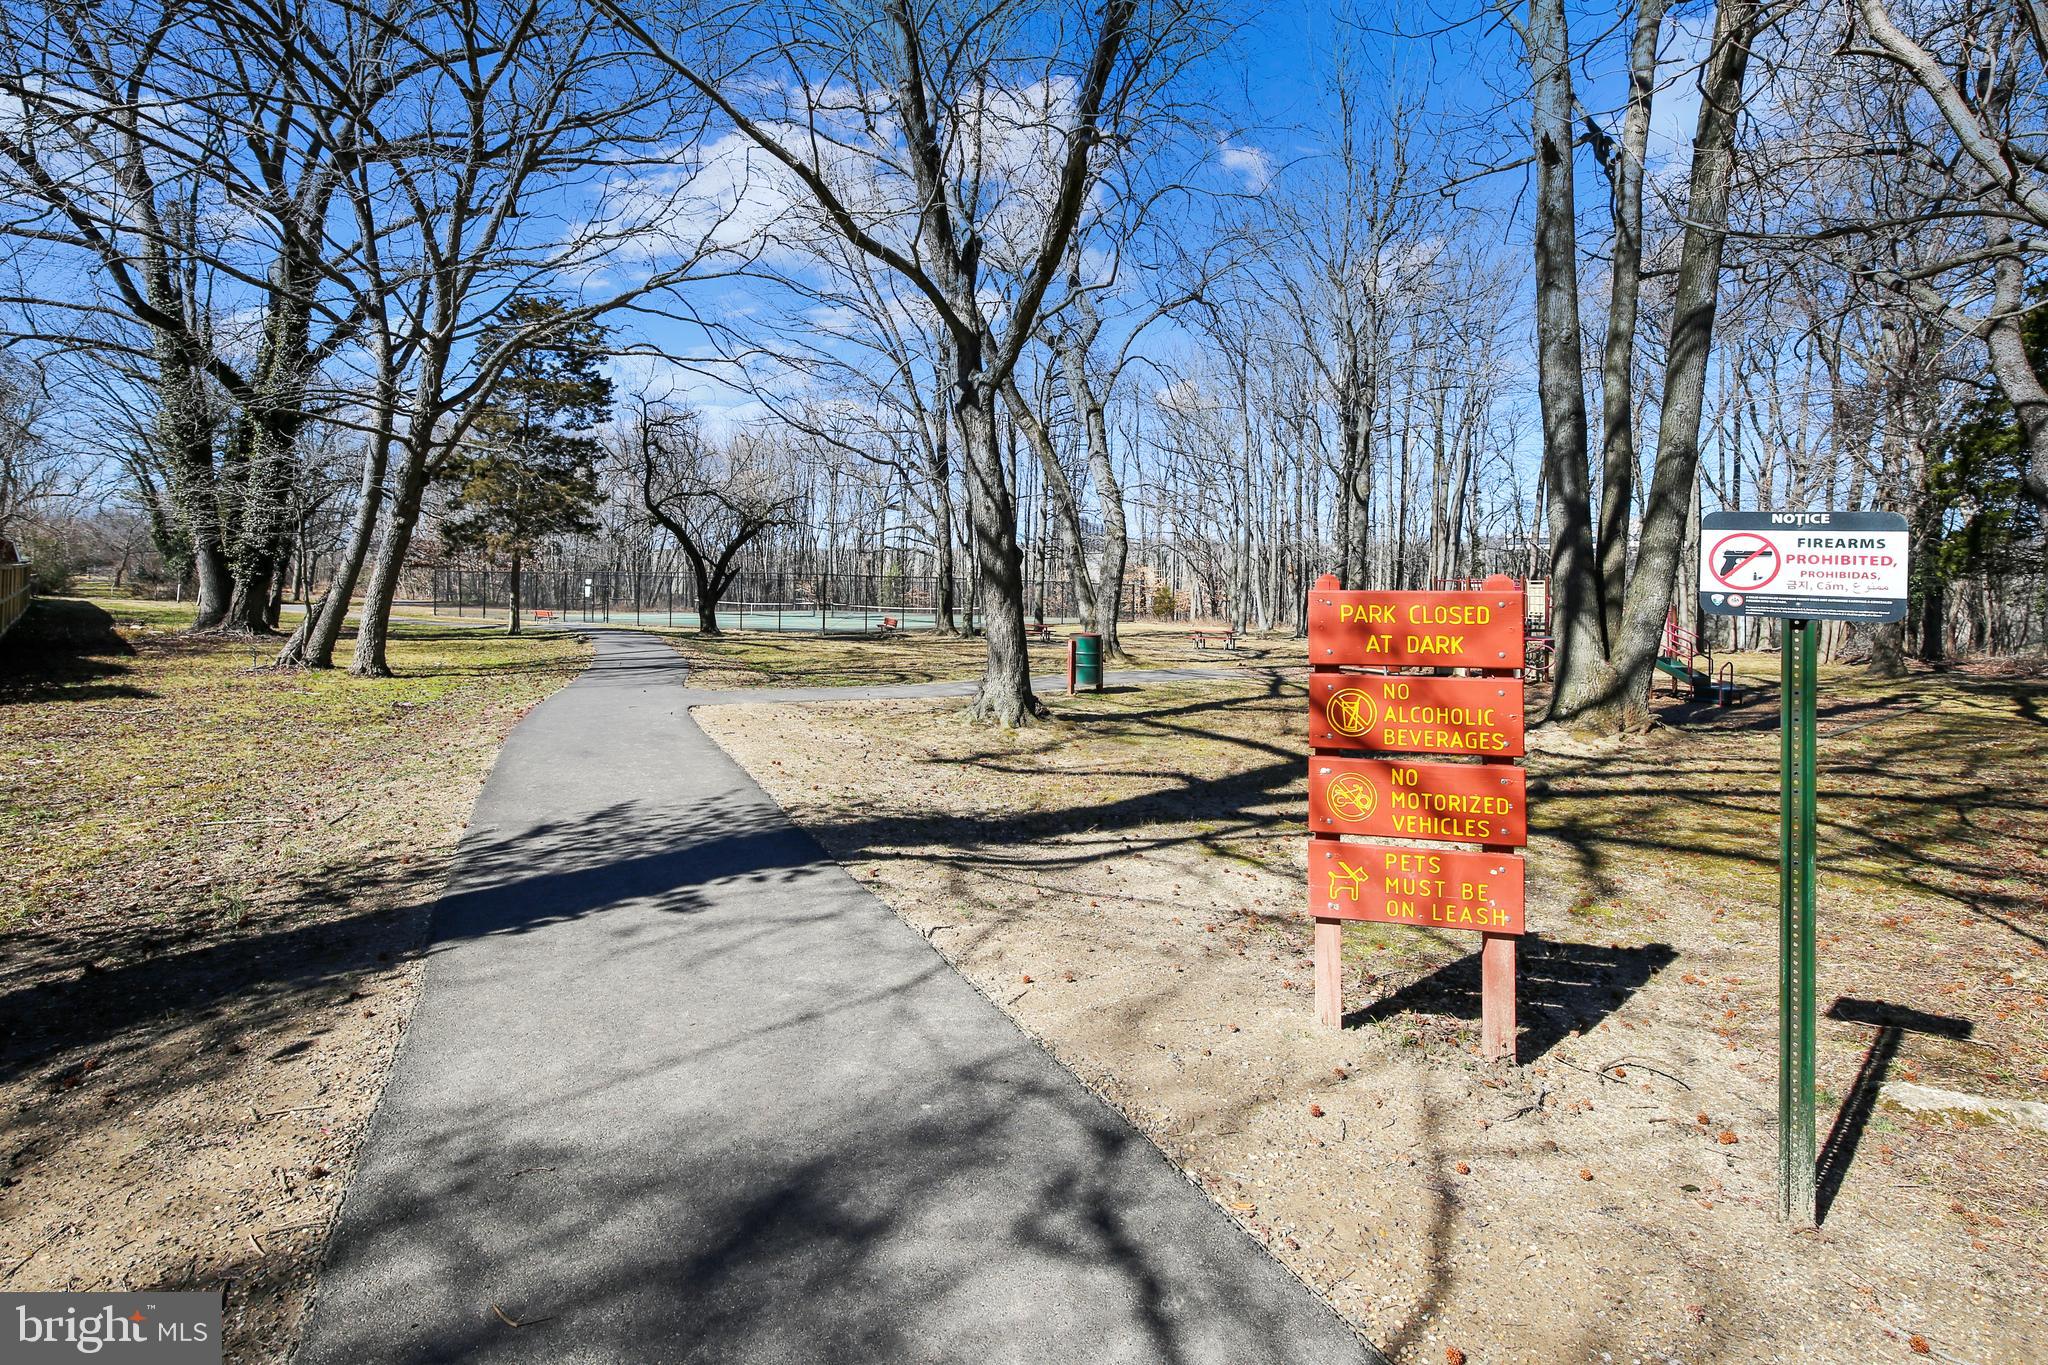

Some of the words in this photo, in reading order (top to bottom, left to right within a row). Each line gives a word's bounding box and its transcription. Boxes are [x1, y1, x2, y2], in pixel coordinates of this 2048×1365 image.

[1771, 513, 1831, 526] NOTICE
[1797, 537, 1886, 549] FIREARMS
[1785, 554, 1898, 568] PROHIBITED,
[1800, 570, 1881, 581] PROHIBIDAS,
[1340, 604, 1396, 624] PARK
[1408, 605, 1491, 625] CLOSED
[1366, 634, 1393, 654] AT
[1406, 635, 1465, 655] DARK
[1383, 683, 1410, 700] NO
[1383, 706, 1495, 727] ALCOHOLIC
[1383, 728, 1505, 751] BEVERAGES
[1391, 768, 1419, 787] NO
[1391, 791, 1510, 816] MOTORIZED
[1391, 814, 1491, 839] VEHICLES
[1384, 852, 1442, 875] PETS
[1385, 876, 1446, 899] MUST
[1461, 883, 1489, 902] BE
[1385, 900, 1415, 919] ON
[1432, 904, 1506, 927] LEASH
